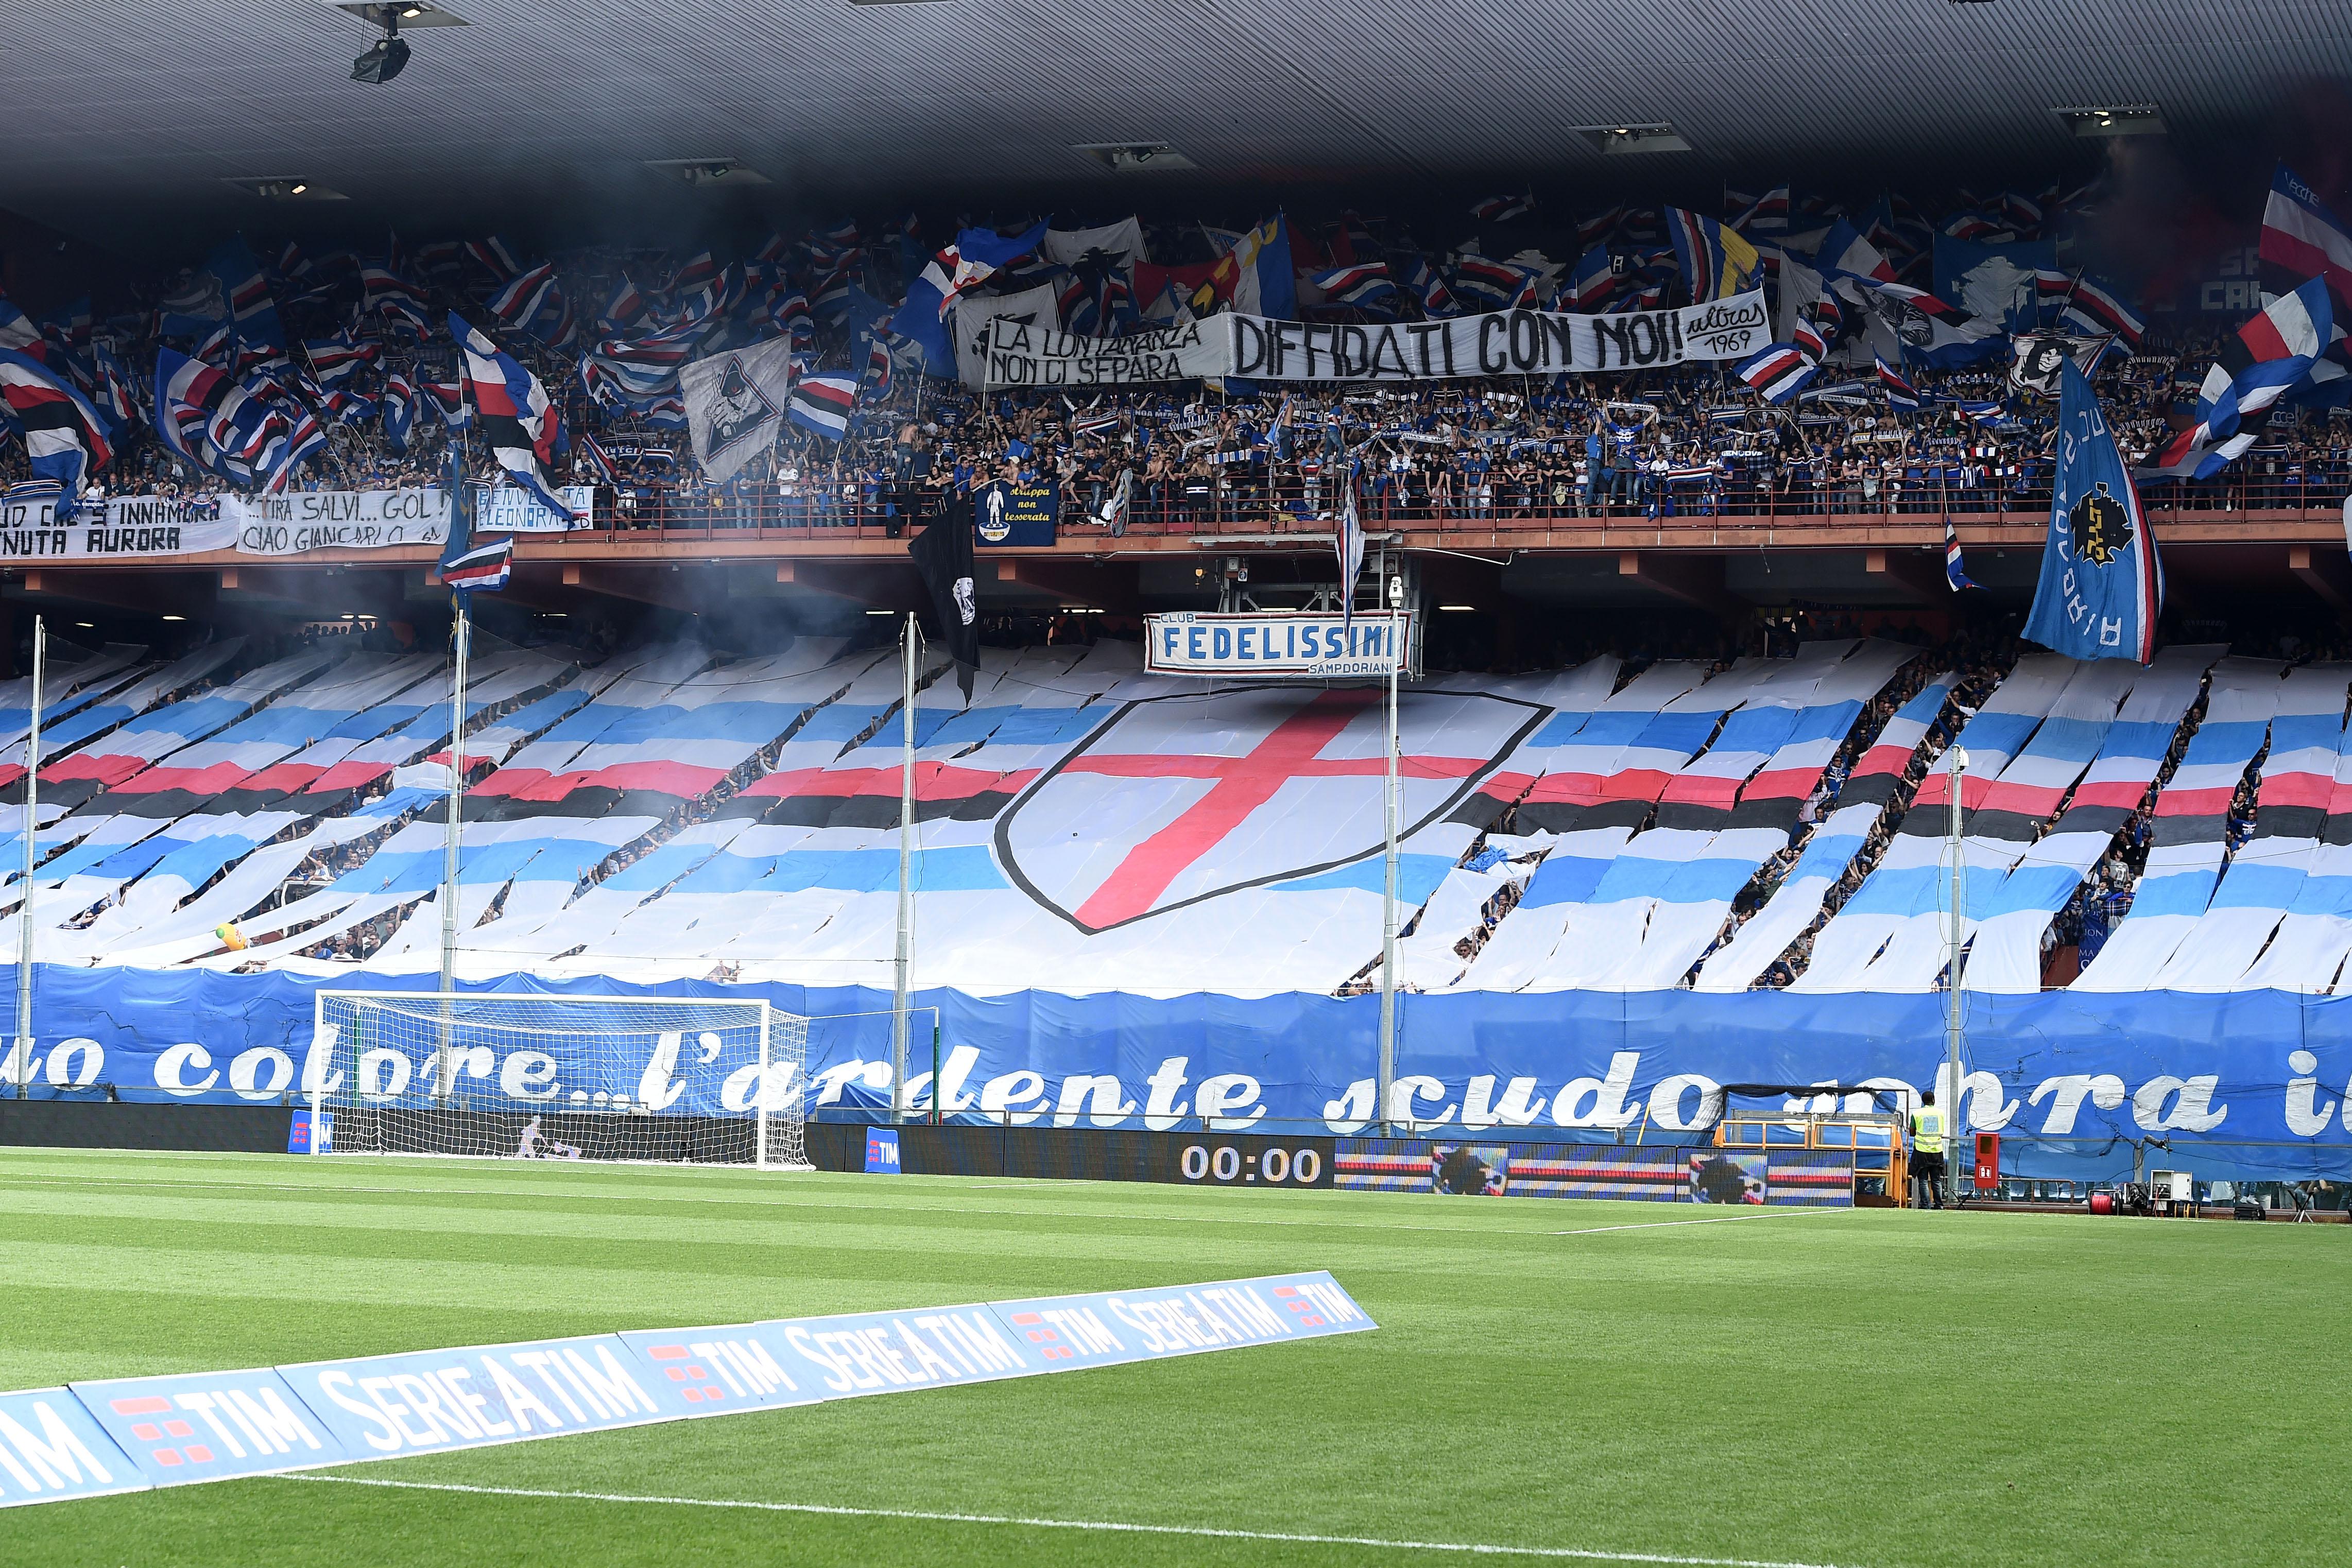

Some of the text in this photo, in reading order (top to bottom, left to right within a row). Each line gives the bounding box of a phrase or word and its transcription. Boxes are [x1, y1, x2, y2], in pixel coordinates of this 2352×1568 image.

[1687, 303, 1765, 334] ultras
[994, 319, 1031, 353] LA
[1236, 308, 1684, 377] DIFFIDATI CON NOI!
[1704, 330, 1751, 354] 1969
[991, 352, 1037, 384] NON
[1045, 358, 1067, 384] CI
[1010, 486, 1051, 498] struppa
[1004, 511, 1051, 522] tesserata
[87, 526, 181, 553] AURORA
[244, 526, 288, 553] CIAO
[1160, 613, 1194, 624] CLUB
[1163, 625, 1393, 660] FEDELISSIMI
[1323, 1052, 1725, 1133] scudo
[879, 1141, 899, 1165] TIM
[1181, 1145, 1320, 1182] 00:00
[1295, 1282, 1364, 1324] TIM
[1040, 1307, 1125, 1356] TIM
[689, 1338, 798, 1398] TIM
[173, 1387, 322, 1458] TIM
